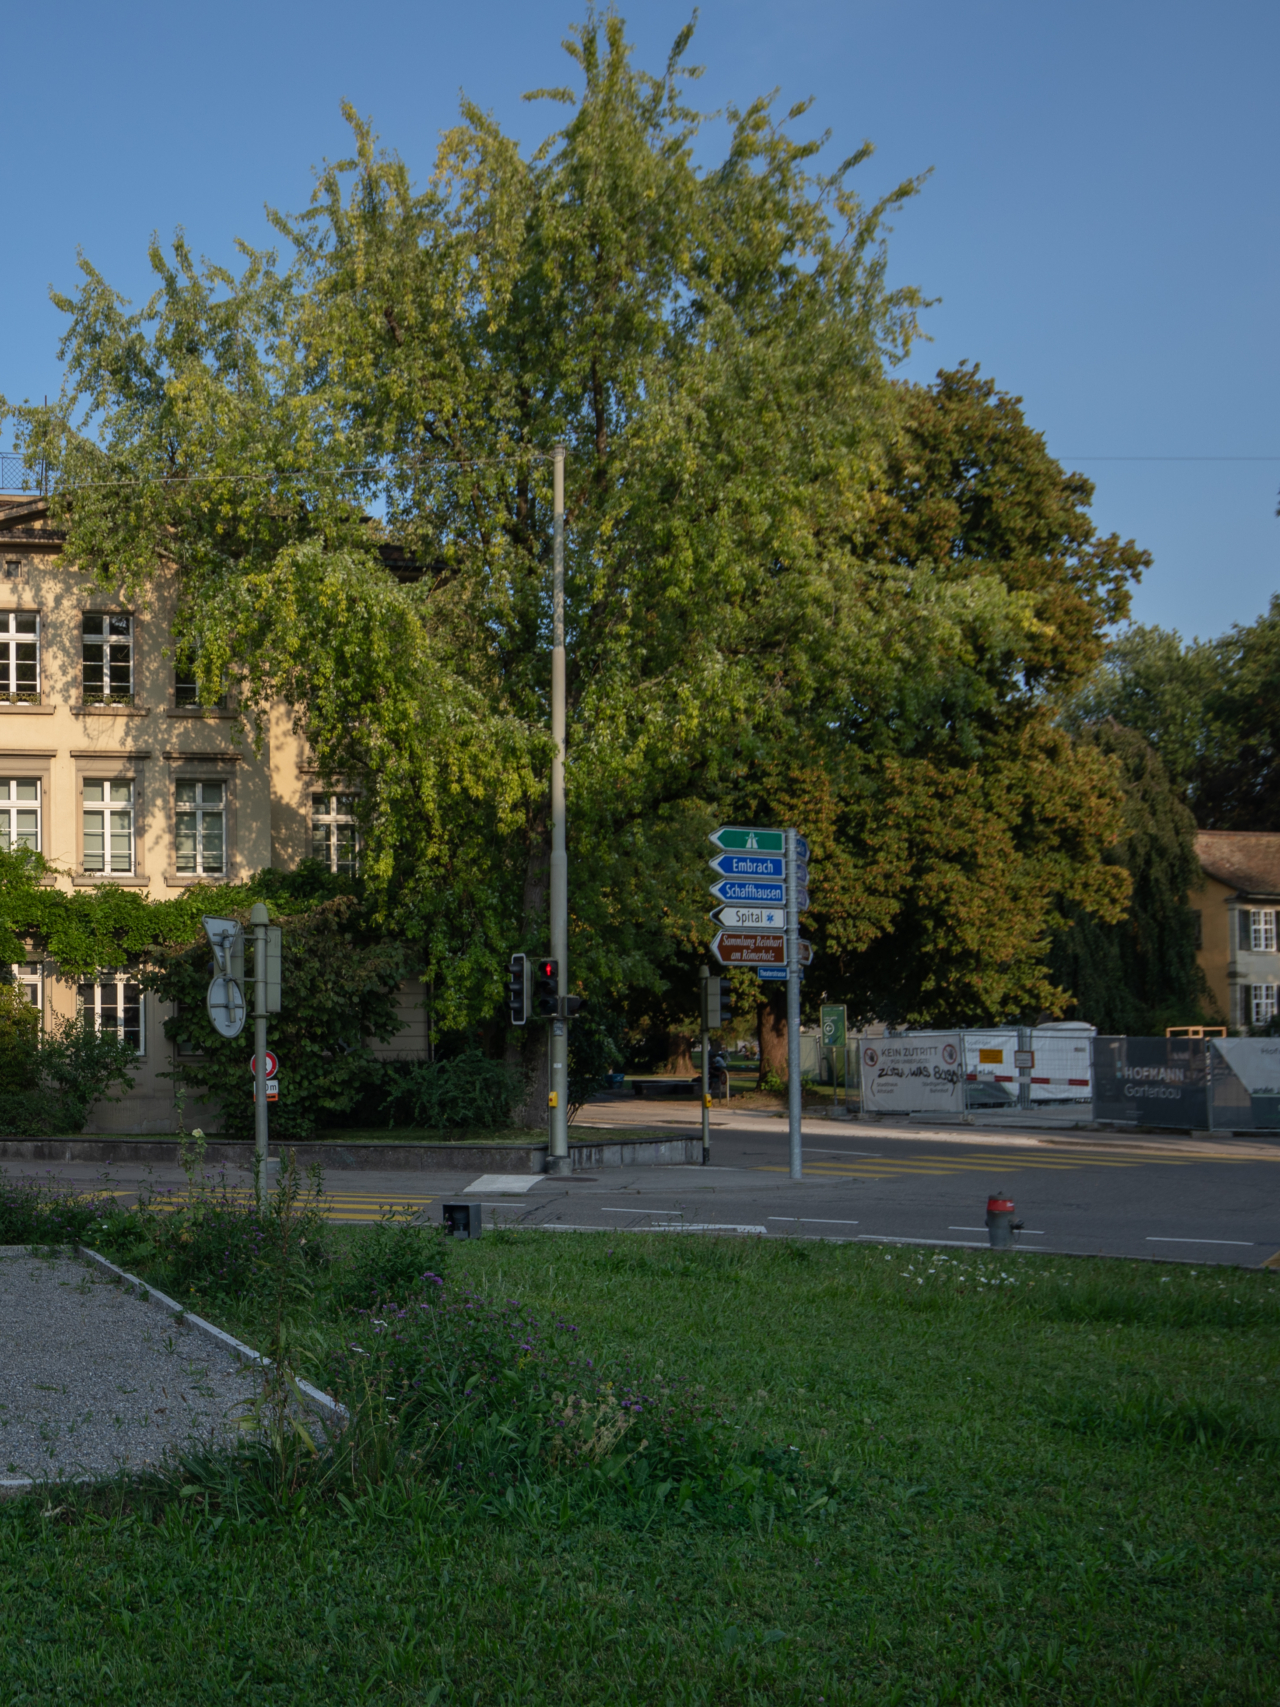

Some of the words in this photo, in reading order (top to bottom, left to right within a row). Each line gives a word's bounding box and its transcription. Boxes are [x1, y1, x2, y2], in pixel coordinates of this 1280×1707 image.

[732, 858, 774, 873] Embrach
[725, 884, 781, 899] Schaffhausen
[735, 910, 763, 925] Spital
[722, 935, 755, 949] Sammlung
[756, 936, 783, 948] Reinhart
[730, 951, 741, 960] am
[741, 950, 776, 961] Römerholz
[881, 1048, 902, 1057] KEIN
[903, 1046, 939, 1057] ZUTRITT
[1124, 1066, 1185, 1081] HOFMANN
[1124, 1083, 1182, 1099] Gartenbau
